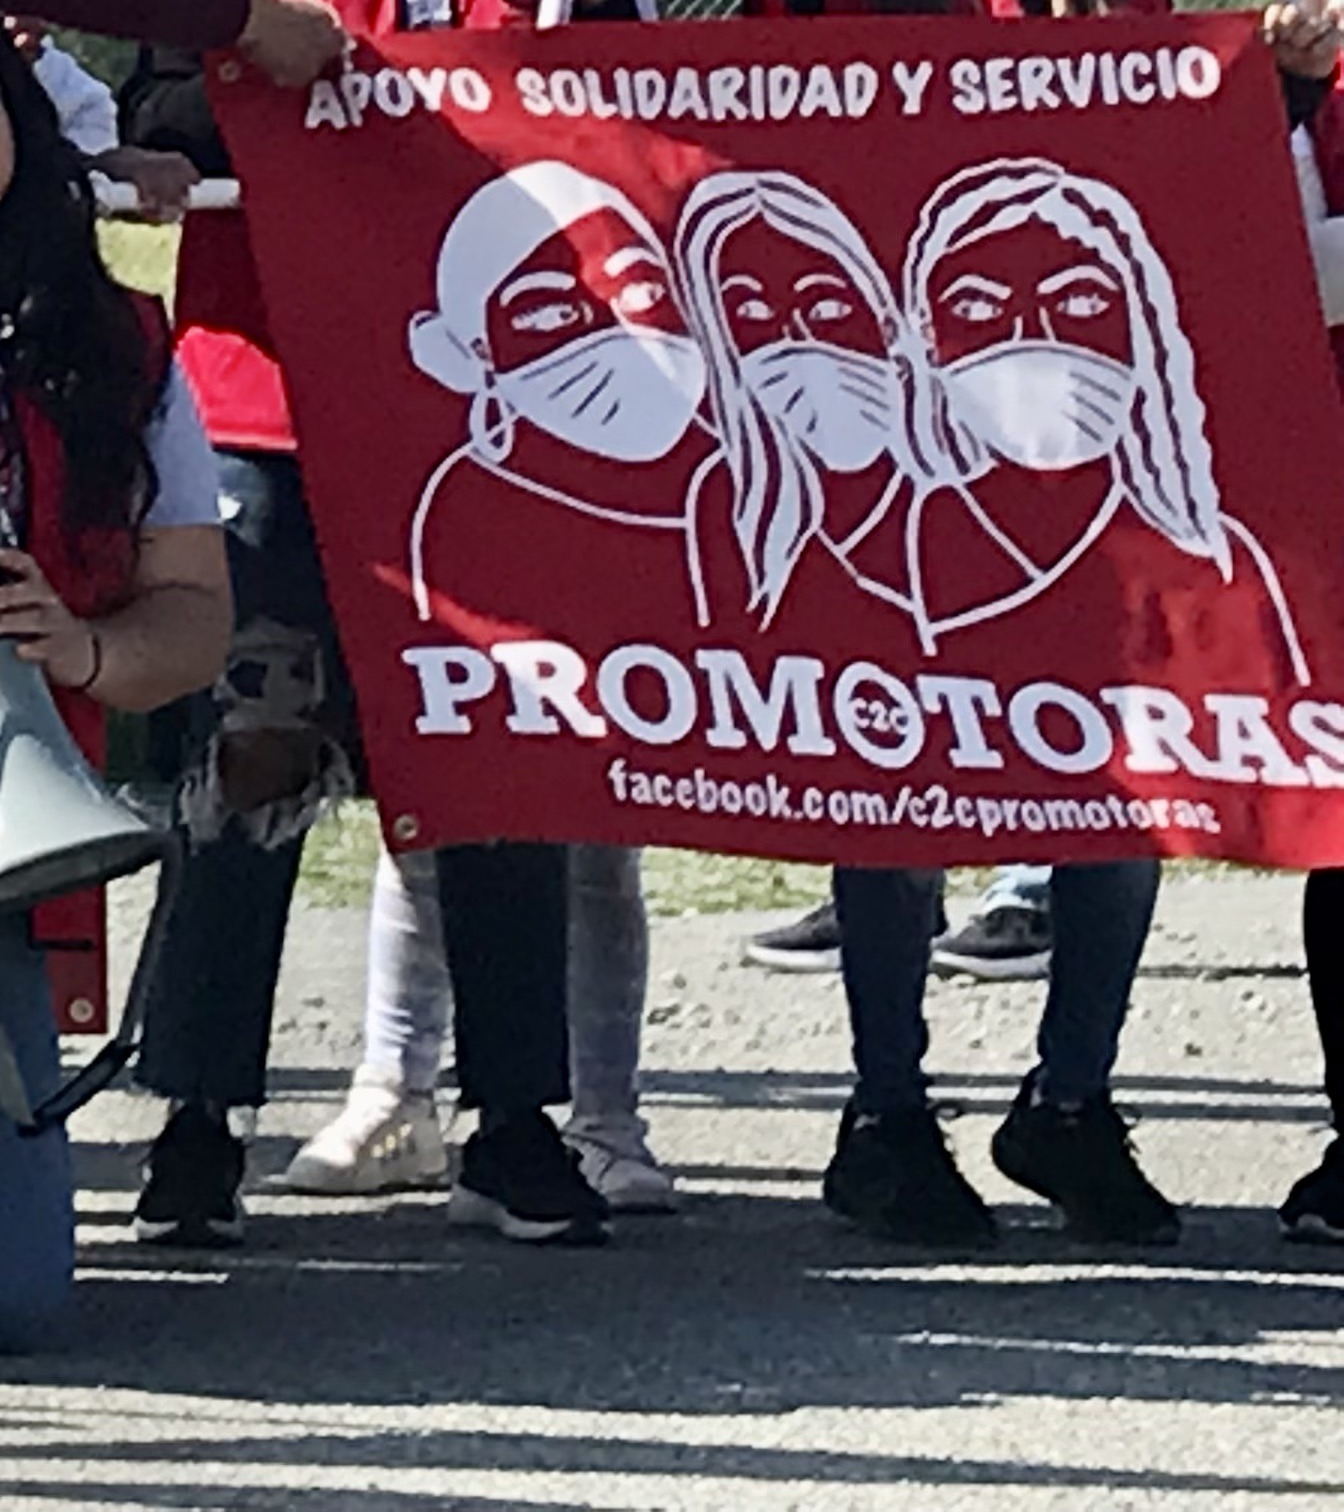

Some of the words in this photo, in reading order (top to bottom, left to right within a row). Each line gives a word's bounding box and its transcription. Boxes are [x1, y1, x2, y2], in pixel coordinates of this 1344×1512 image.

[305, 67, 492, 129] APOYO
[515, 61, 878, 121] SOLIDARIDAD
[892, 61, 933, 115] Y
[950, 45, 1221, 114] SERVICIO
[401, 643, 1344, 789] PROMOTORAS
[849, 696, 910, 736] C2C
[608, 759, 1222, 838] facebook.com/c2cpromotoras
